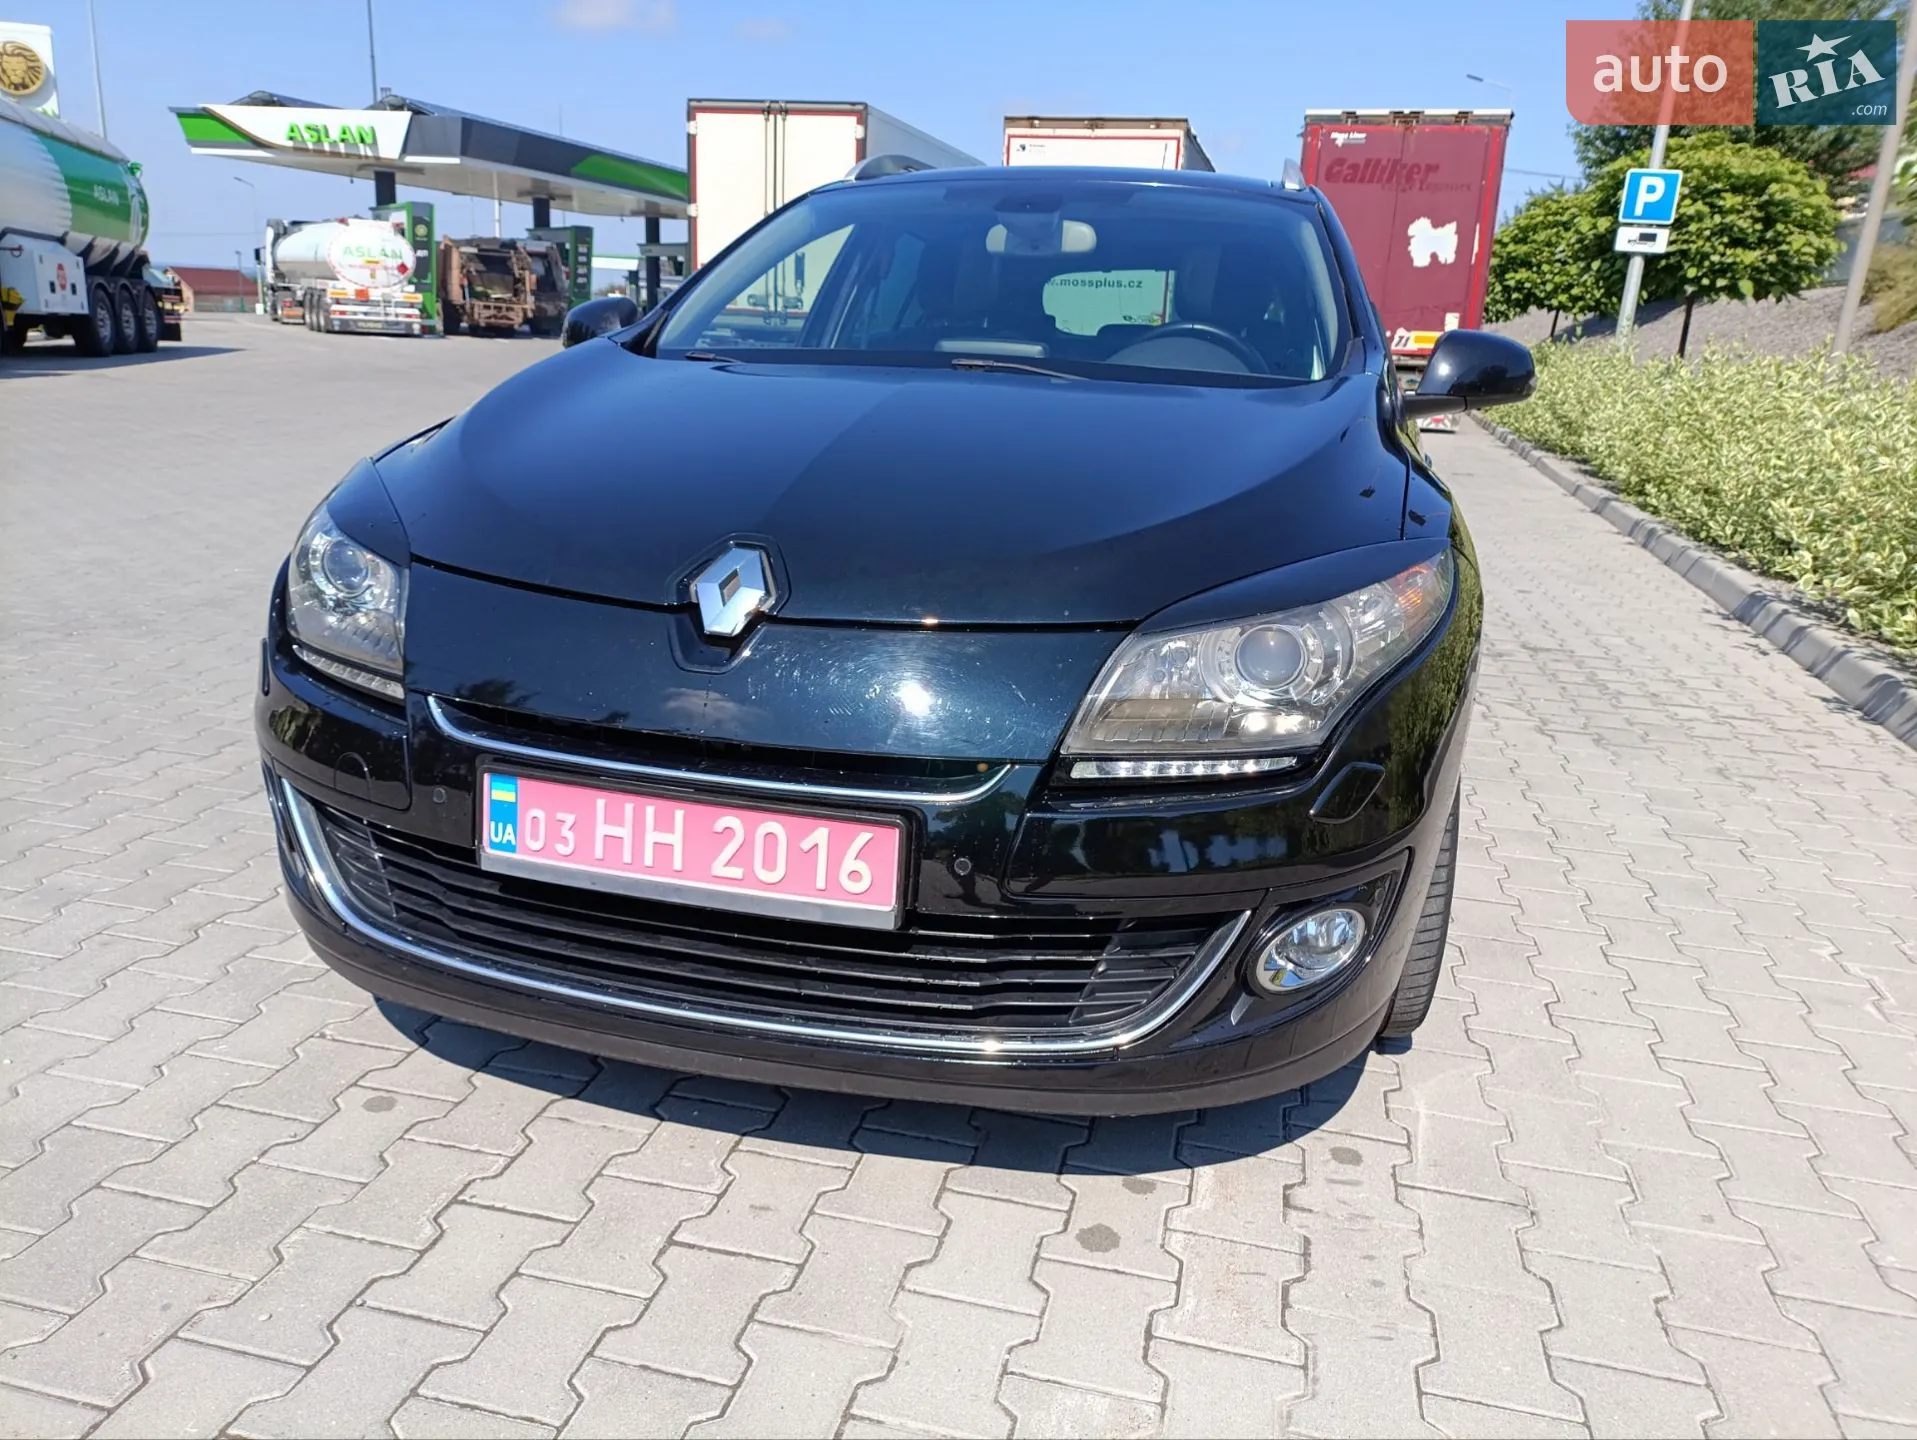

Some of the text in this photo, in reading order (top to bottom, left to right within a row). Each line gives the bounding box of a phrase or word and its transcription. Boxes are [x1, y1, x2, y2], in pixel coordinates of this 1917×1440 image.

[286, 122, 375, 144] ASLAN
[1324, 157, 1440, 185] Galliker
[1634, 175, 1666, 217] P
[343, 245, 403, 260] ASLAN
[490, 820, 517, 846] UA
[525, 798, 875, 895] 03 HH 2016
